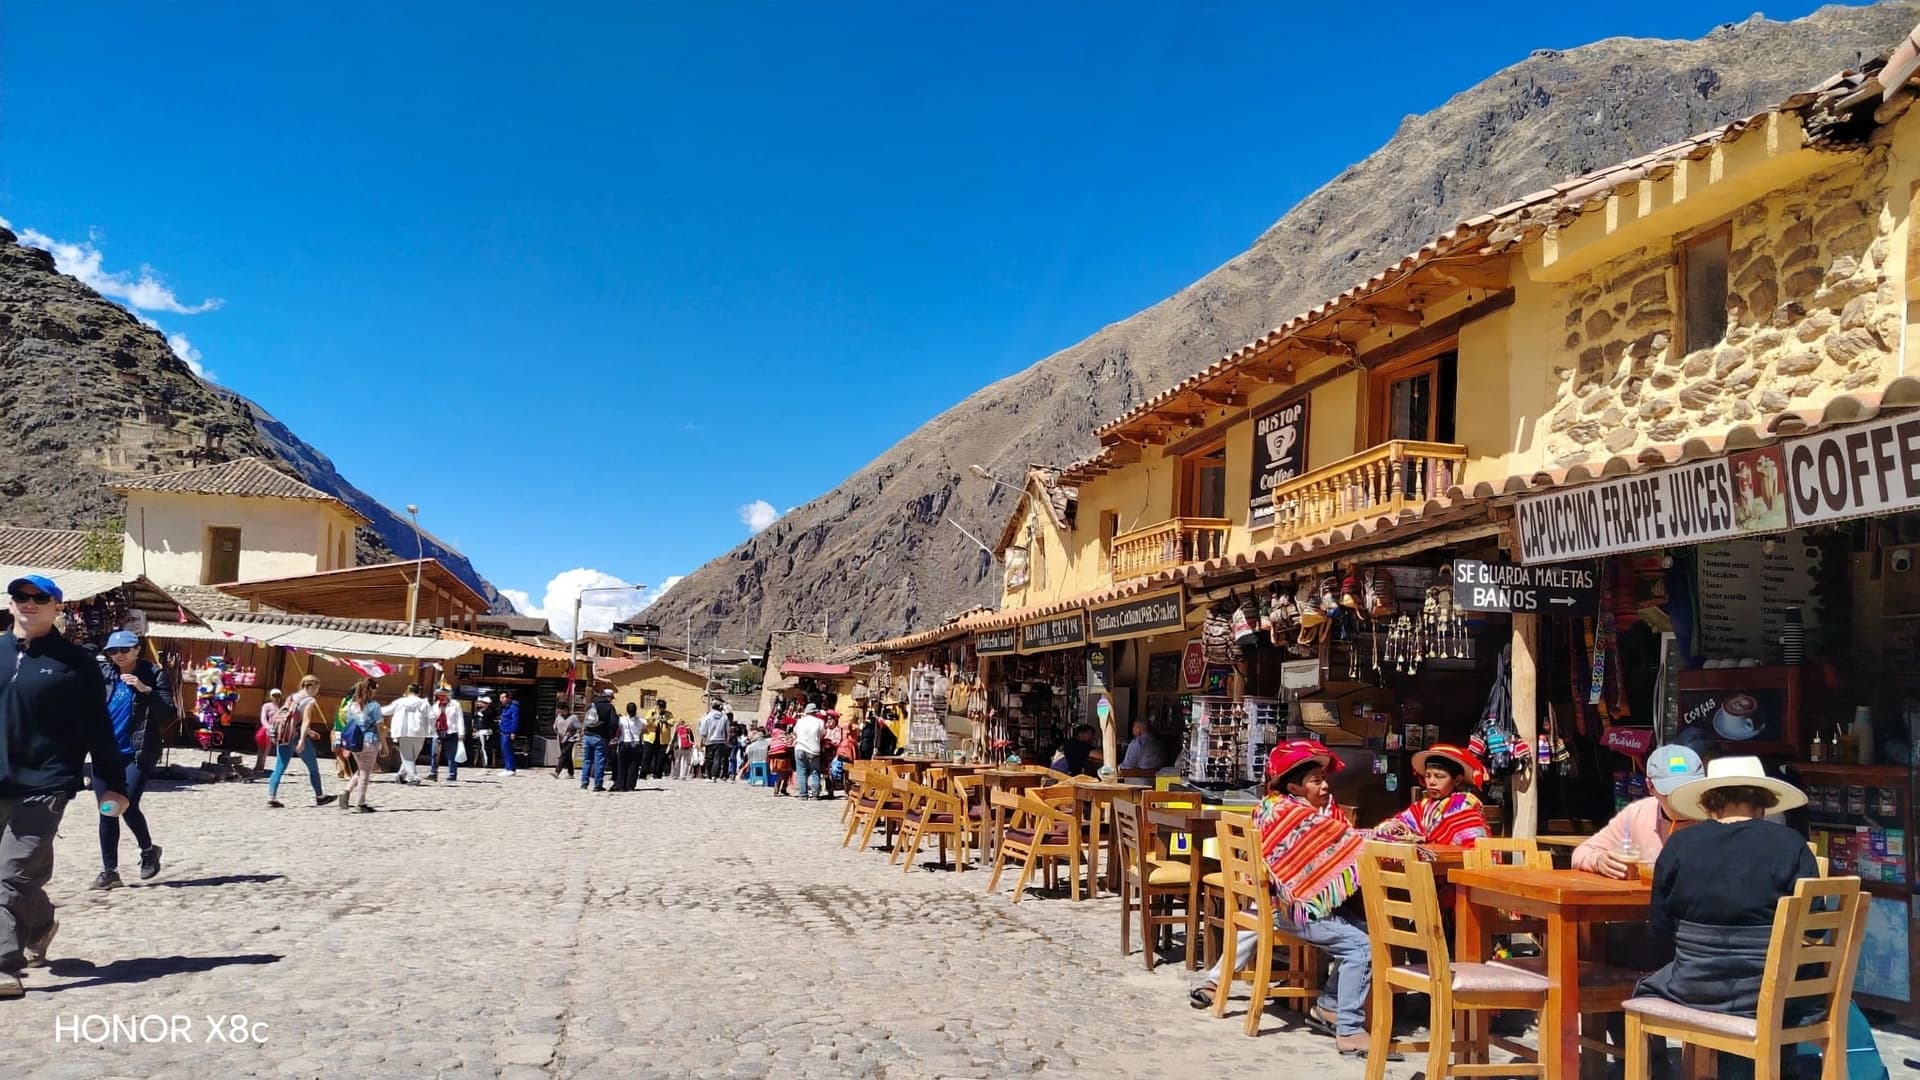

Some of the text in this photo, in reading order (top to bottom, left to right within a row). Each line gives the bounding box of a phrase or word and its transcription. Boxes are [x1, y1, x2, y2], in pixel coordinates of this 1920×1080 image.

[1791, 420, 1920, 516] COFFE
[1520, 463, 1732, 559] CAPUCCINO FRAPPE JUICES
[1457, 564, 1593, 589] SE GUARDA MALETAS
[1473, 585, 1537, 610] BAÑOS
